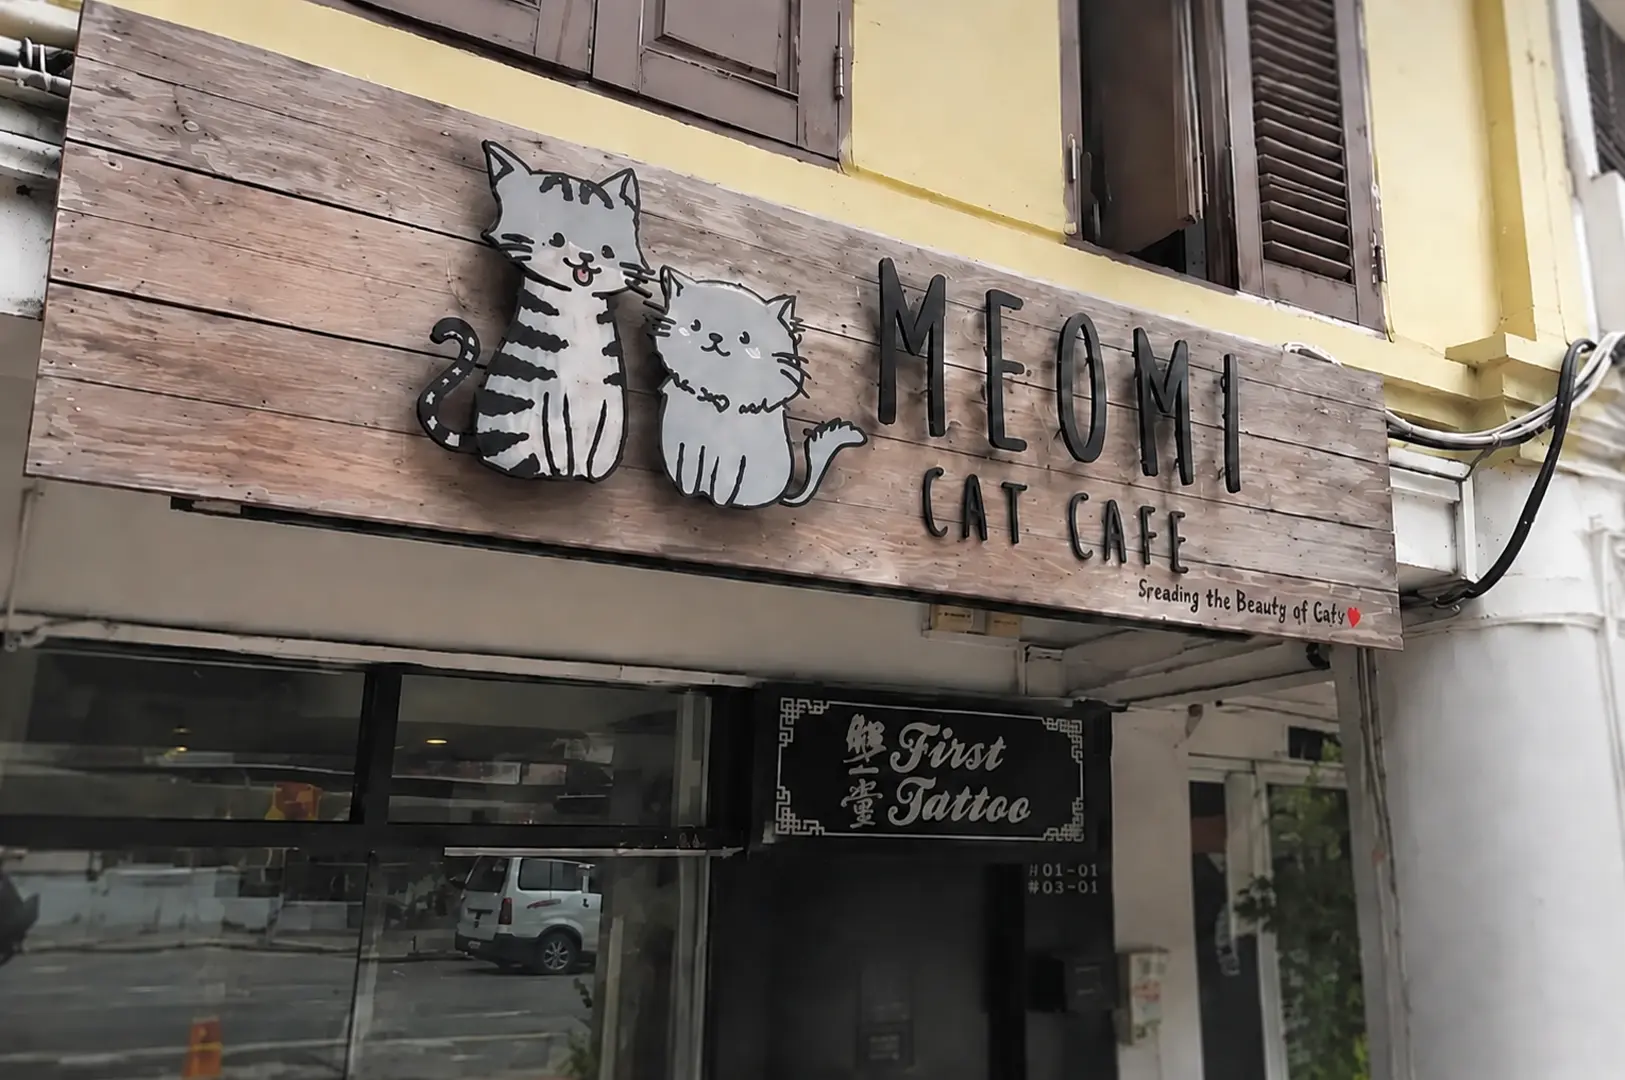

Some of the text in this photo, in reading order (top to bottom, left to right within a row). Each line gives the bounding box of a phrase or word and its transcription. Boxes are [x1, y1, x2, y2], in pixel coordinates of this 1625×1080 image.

[877, 257, 1242, 494] MEOMI
[921, 466, 1189, 574] CAT CAFE
[1206, 589, 1231, 610] the
[1236, 590, 1286, 624] Beauty
[1293, 600, 1308, 625] of
[890, 722, 1007, 773] First
[887, 776, 1031, 826] Tattoo
[1028, 880, 1098, 894] #03-01
[1029, 863, 1098, 877] #01-01
